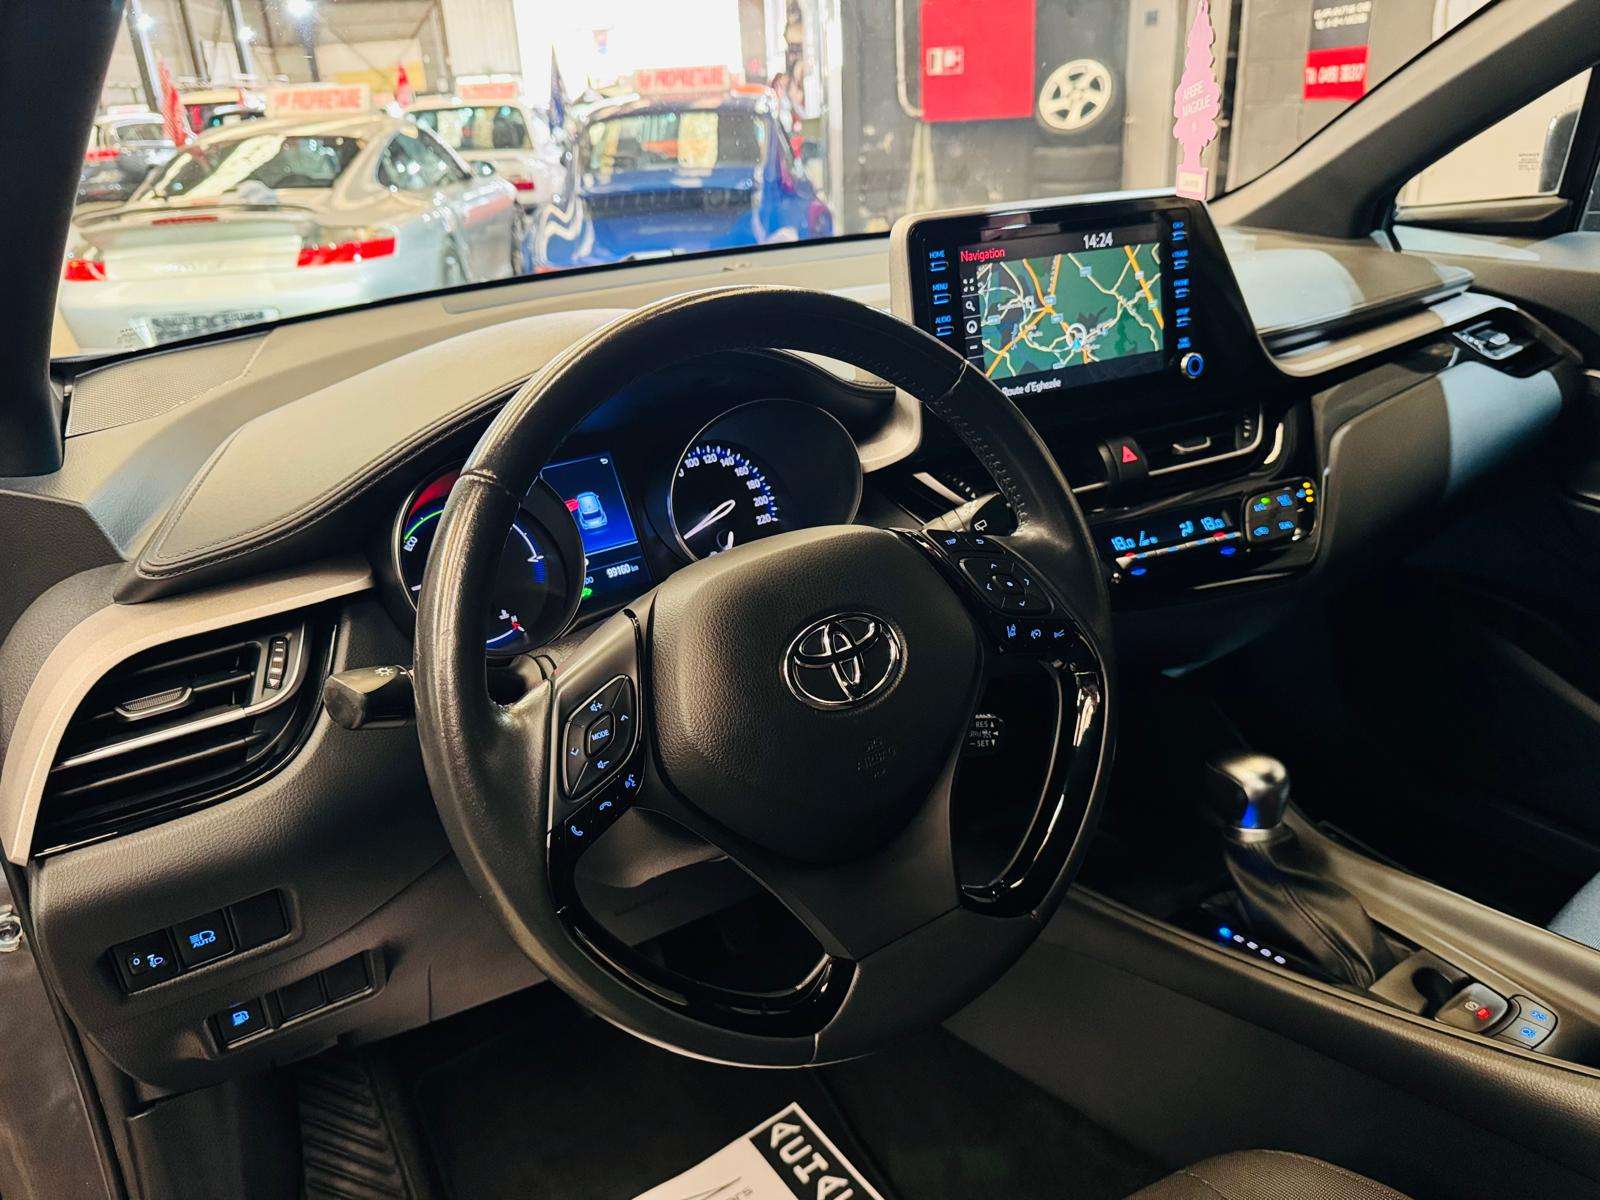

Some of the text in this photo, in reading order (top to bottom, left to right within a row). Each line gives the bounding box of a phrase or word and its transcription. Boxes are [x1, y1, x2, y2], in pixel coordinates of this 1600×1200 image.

[1083, 232, 1113, 249] 14:24
[929, 249, 945, 258] HOME
[960, 248, 1005, 262] Navigation
[932, 282, 948, 291] MENU
[685, 457, 700, 469] 100
[703, 453, 718, 465] 120
[720, 456, 735, 468] 140
[735, 465, 749, 477] 160
[753, 495, 769, 507] 200
[756, 513, 771, 526] 220
[403, 536, 418, 551] ECO
[592, 729, 609, 740] MODE
[193, 935, 216, 949] AUTO
